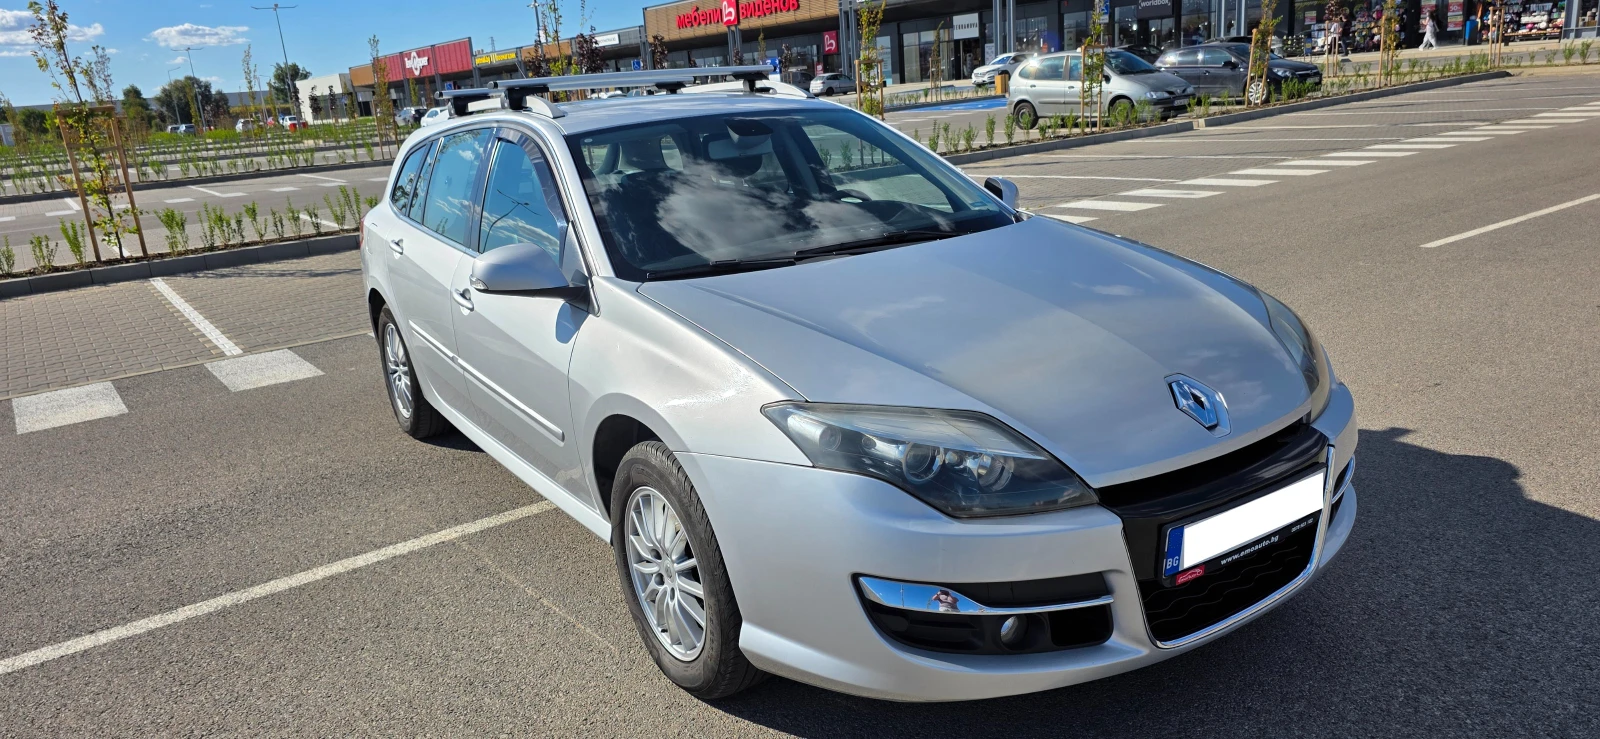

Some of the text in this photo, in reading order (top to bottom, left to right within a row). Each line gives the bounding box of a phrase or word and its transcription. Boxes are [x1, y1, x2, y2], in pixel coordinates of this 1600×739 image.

[676, 0, 798, 29] мебели виденов
[1166, 555, 1179, 570] BG
[1221, 534, 1279, 565] www.emoauto.bg
